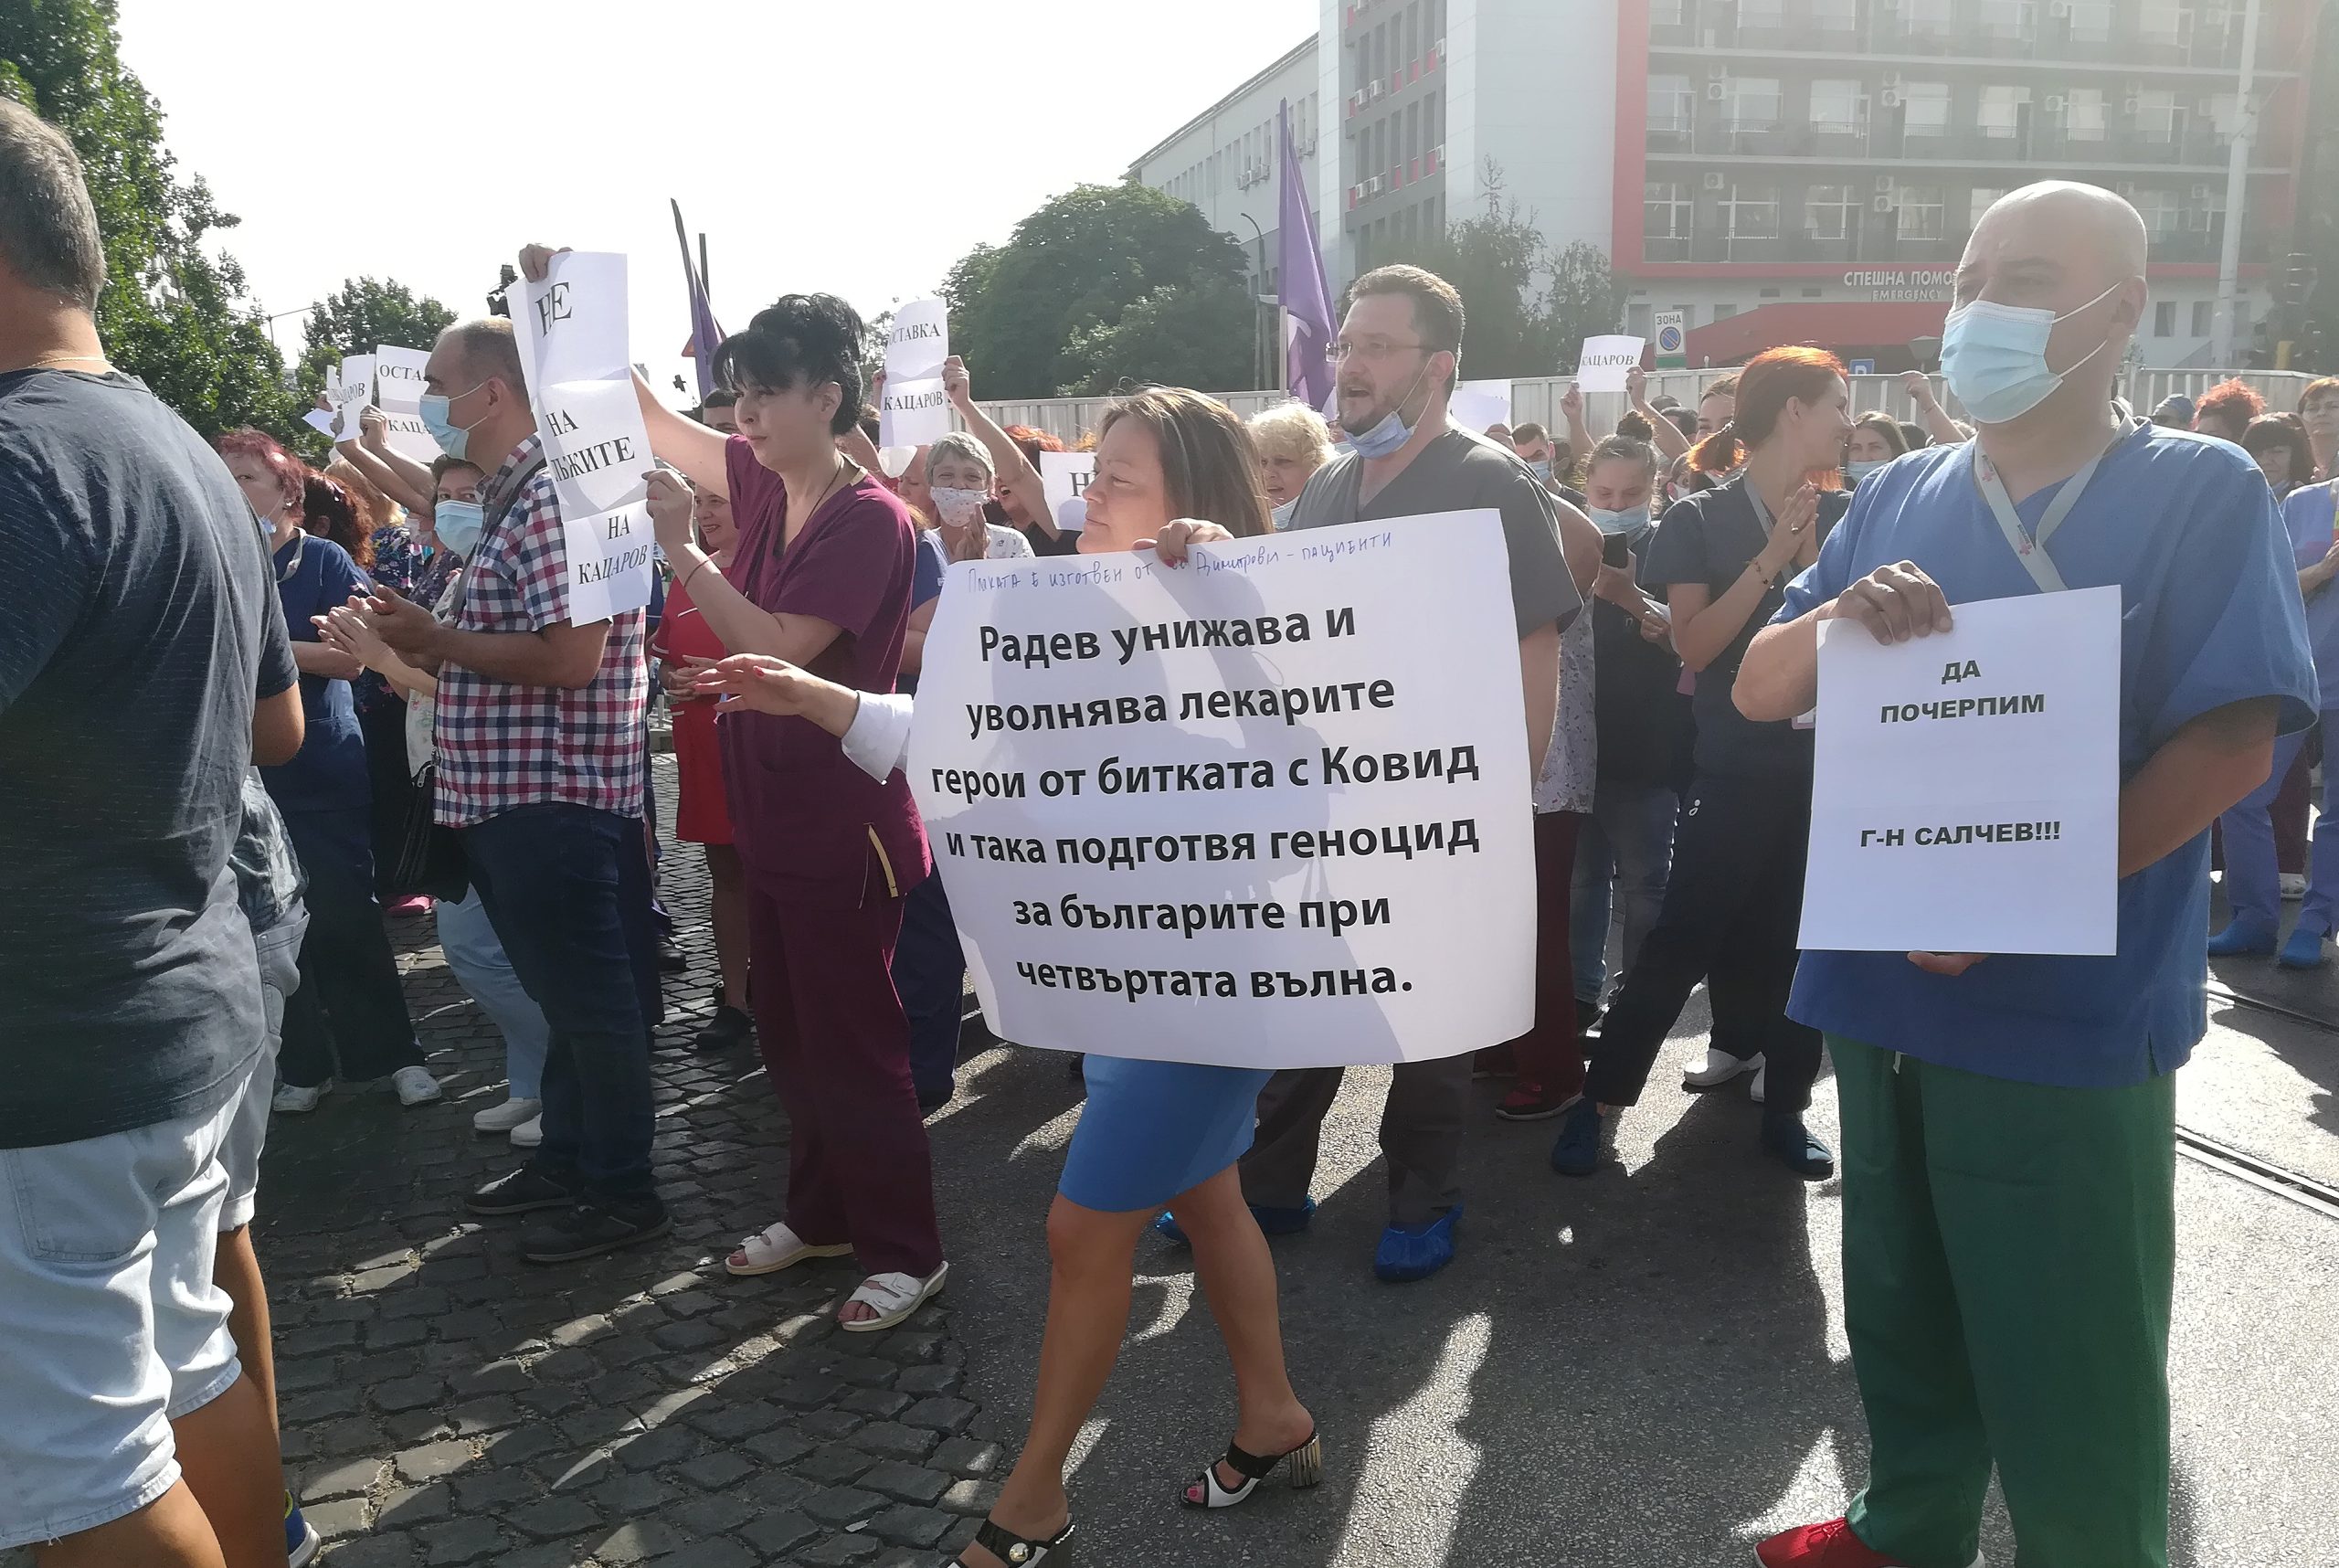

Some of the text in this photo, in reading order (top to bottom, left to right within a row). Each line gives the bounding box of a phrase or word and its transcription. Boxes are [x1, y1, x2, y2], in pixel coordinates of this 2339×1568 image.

[1844, 270, 1953, 286] СПЕШНА ПОМО
[535, 281, 572, 338] НЕ
[1871, 289, 1942, 301] EMERGENCY
[1656, 313, 1682, 325] ЗОНА
[379, 365, 422, 381] ОСТА
[884, 391, 943, 412] КАЦАРОВ
[545, 408, 579, 437] НА
[607, 514, 630, 540] НА
[578, 545, 648, 585] КАЦАРОВ
[980, 607, 1356, 669] Радев унижава и
[1941, 660, 1982, 685] ДА
[966, 679, 1394, 740] уволнява лекарите
[1880, 694, 2045, 724] ПОЧЕРПИМ
[931, 745, 1479, 803] герои от битката с Ковид
[946, 818, 1480, 872] и така подготвя геноцид
[1860, 821, 2061, 848] Г-Н САЛЧЕВ!!!
[1012, 893, 1391, 939] за българите при
[1016, 961, 1413, 1003] четвъртата вълна.
